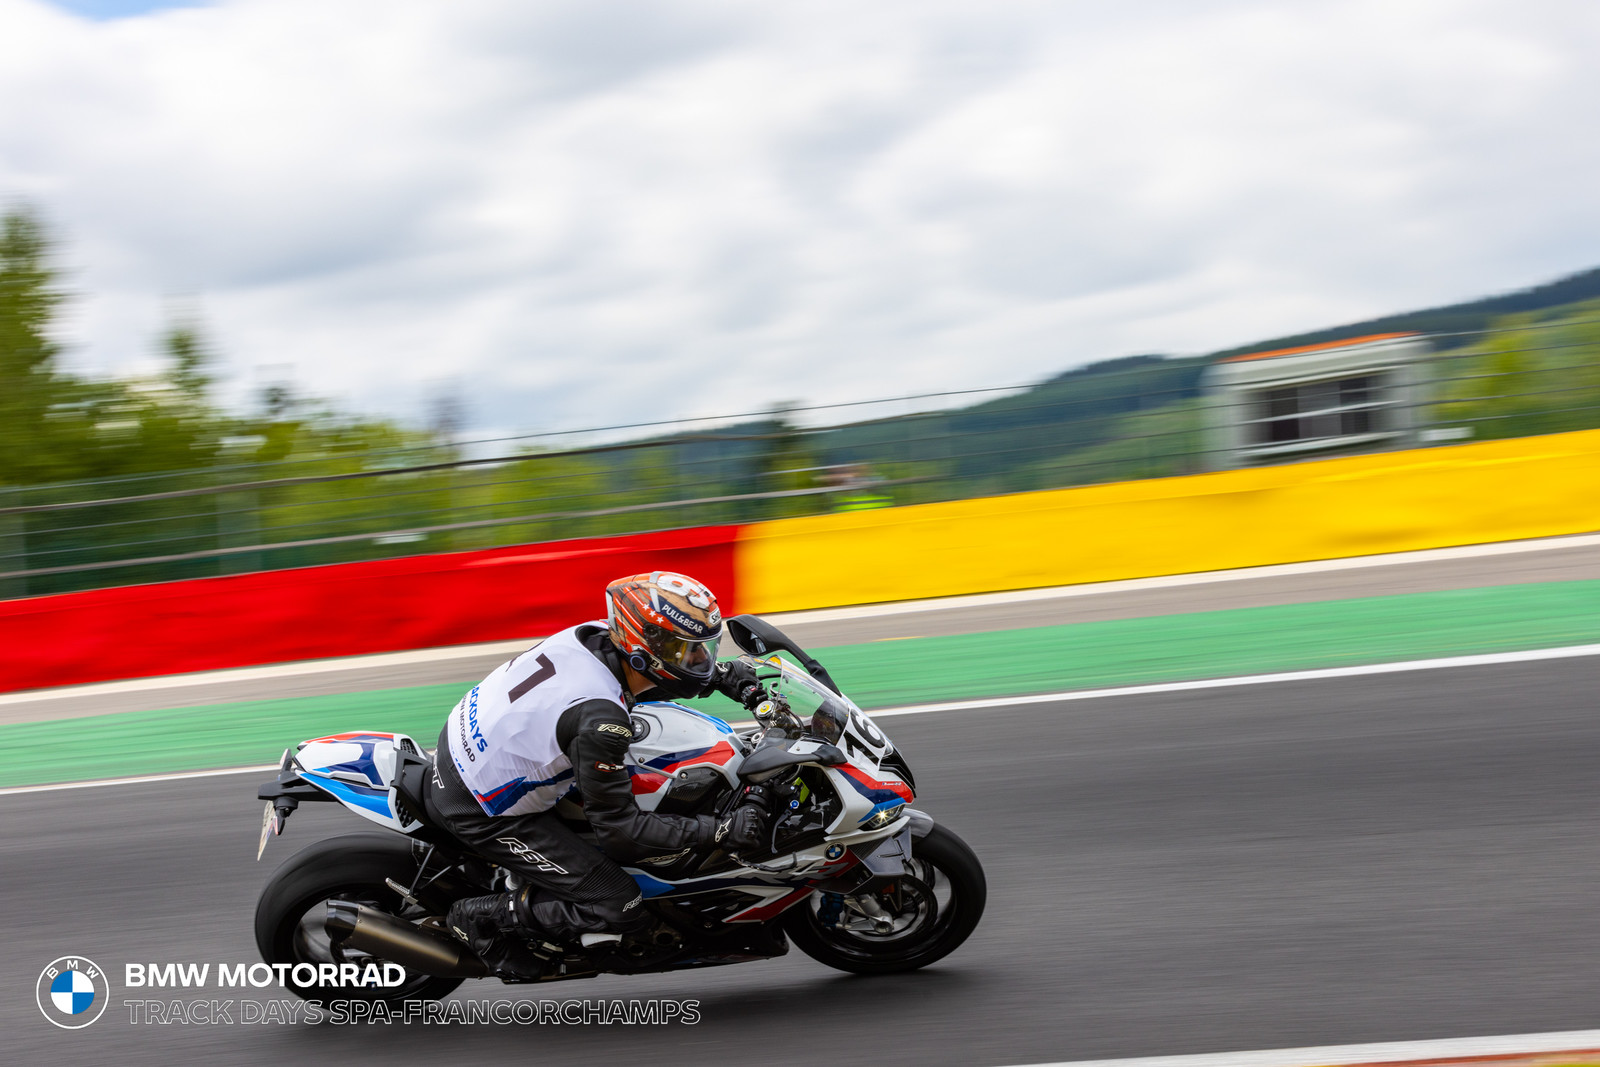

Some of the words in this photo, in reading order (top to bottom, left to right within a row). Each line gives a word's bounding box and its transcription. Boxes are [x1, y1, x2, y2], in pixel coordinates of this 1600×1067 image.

[661, 604, 704, 634] PULL&BEAR
[506, 640, 557, 704] 1
[459, 710, 476, 763] MOTORRAD
[468, 686, 489, 753] ACKDAYS
[843, 708, 886, 767] 16
[496, 837, 569, 875] RST
